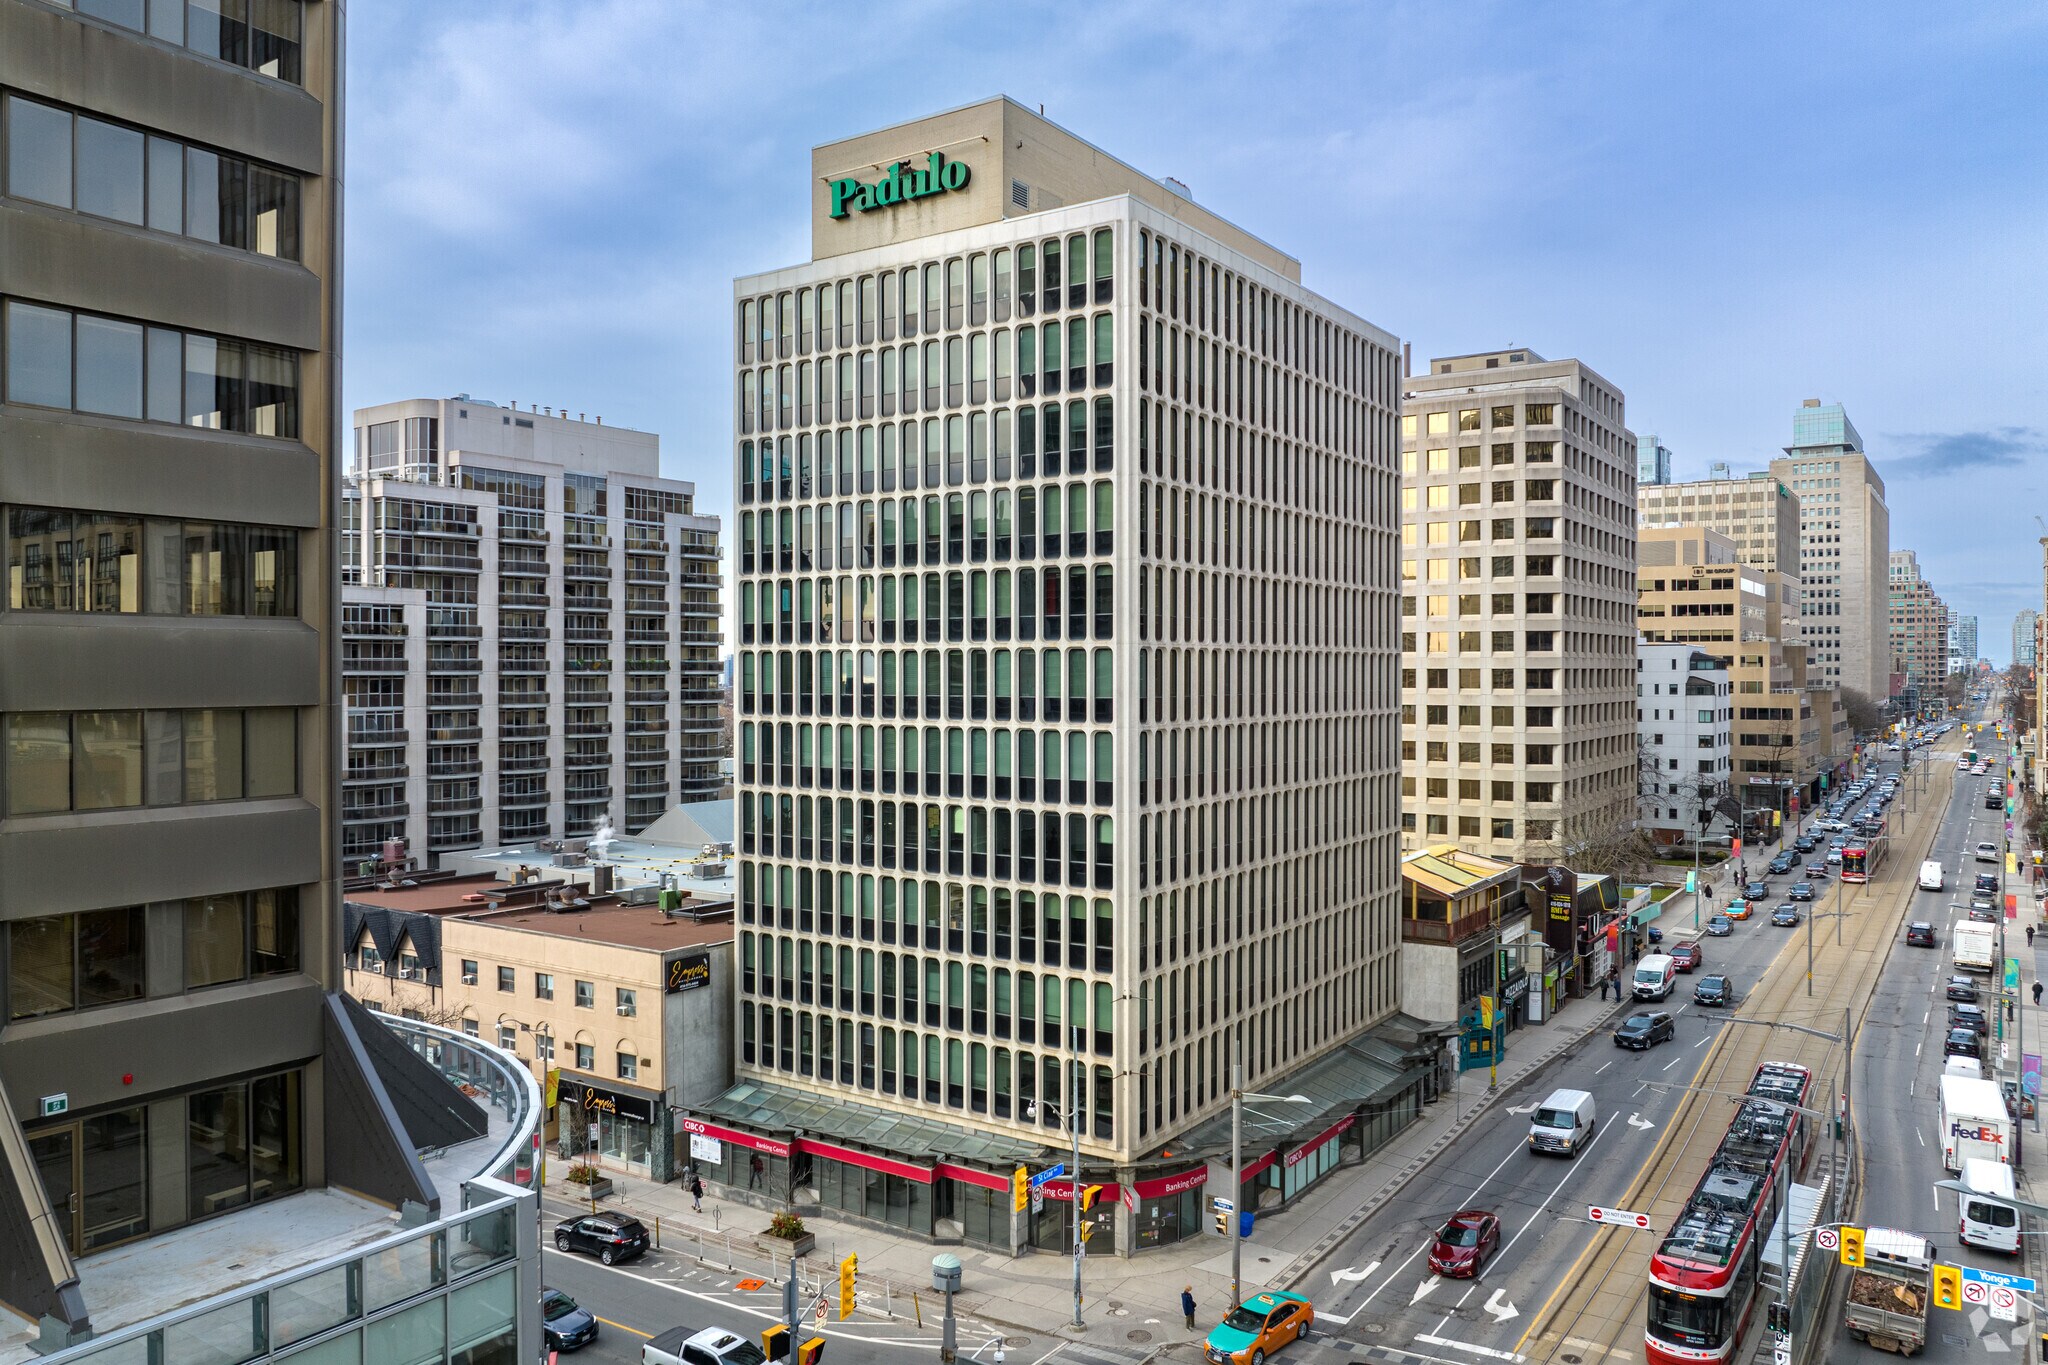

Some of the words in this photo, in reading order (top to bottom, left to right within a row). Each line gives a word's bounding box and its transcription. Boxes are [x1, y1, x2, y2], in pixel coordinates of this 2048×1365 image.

[829, 151, 969, 219] Padulo
[1551, 913, 1570, 921] Massage
[684, 1121, 699, 1131] CIBC
[1951, 1123, 2004, 1145] FedEx
[756, 1141, 773, 1152] Banking
[773, 1145, 788, 1155] Centre
[1038, 1174, 1043, 1182] St
[1044, 1168, 1054, 1180] Clair
[1165, 1179, 1190, 1192] Banking
[1190, 1173, 1207, 1184] Centre
[1979, 1271, 2011, 1286] Yonge
